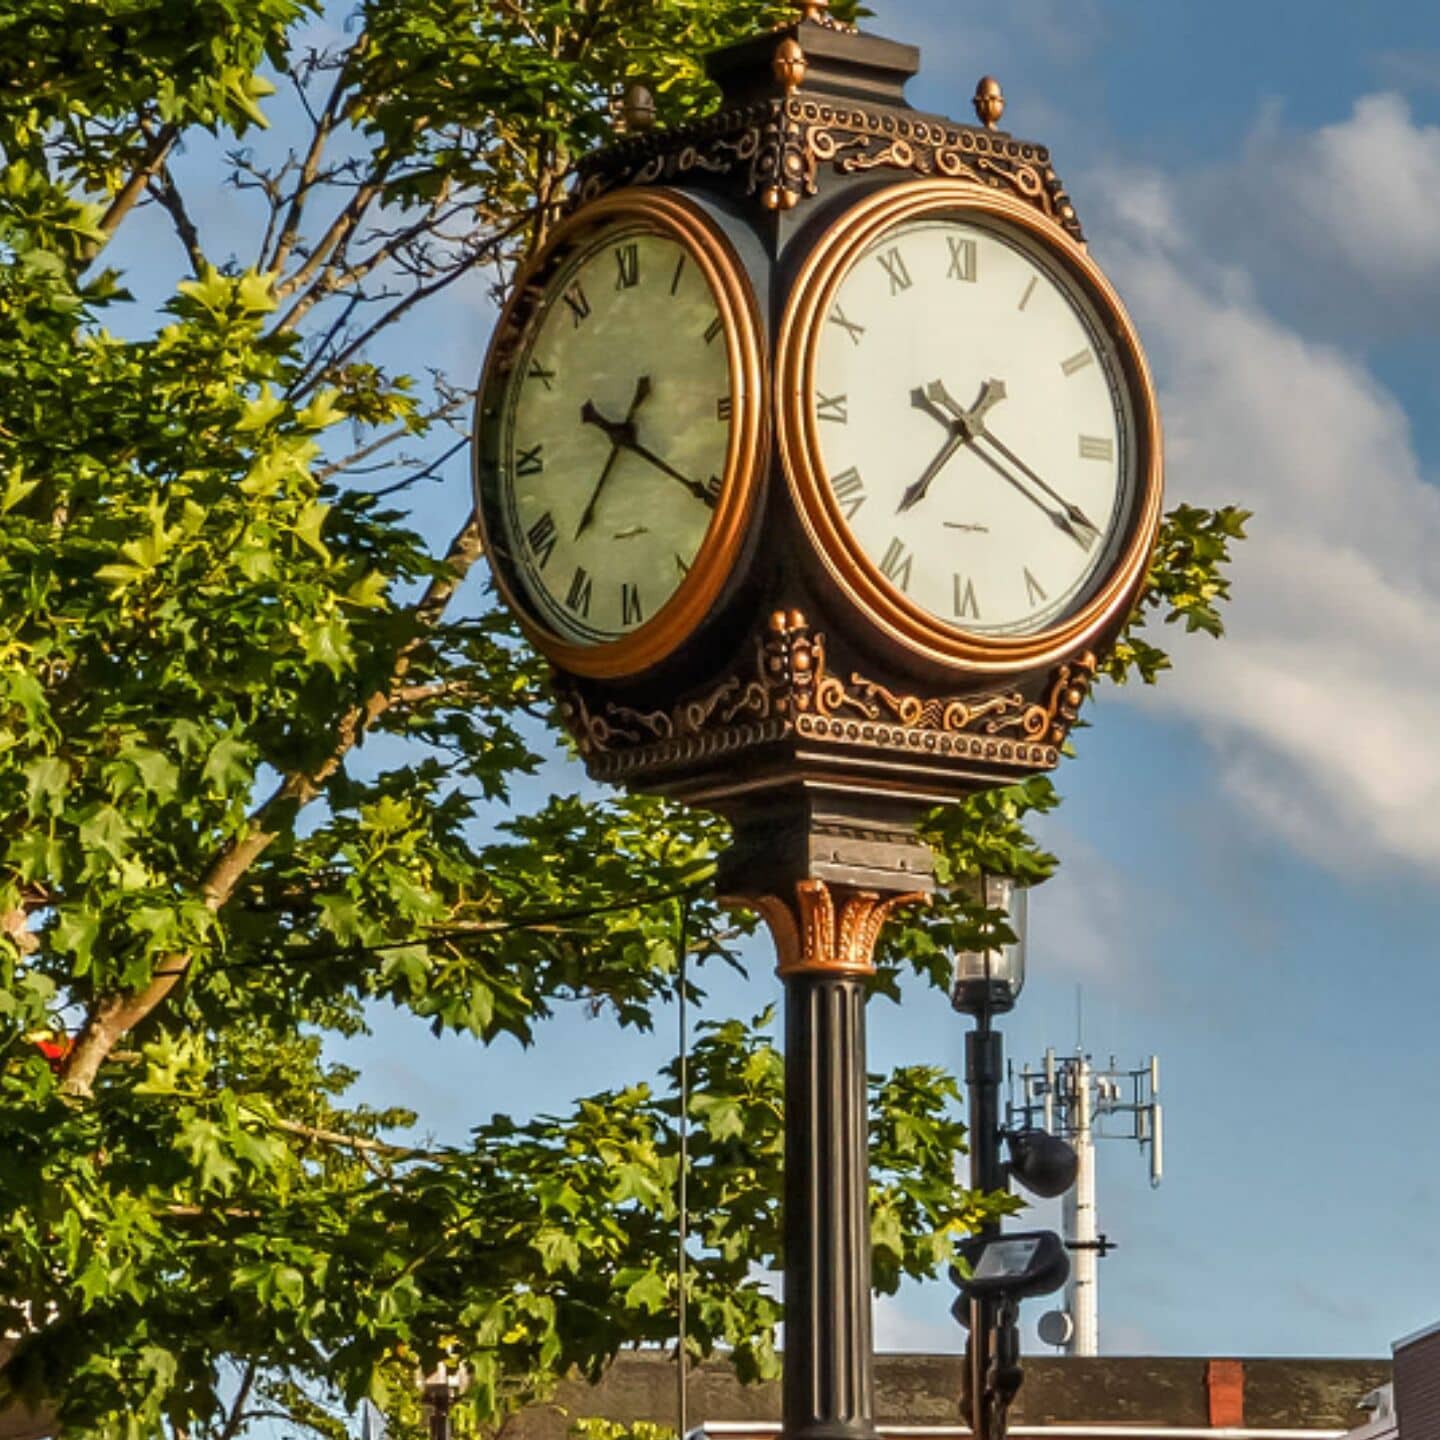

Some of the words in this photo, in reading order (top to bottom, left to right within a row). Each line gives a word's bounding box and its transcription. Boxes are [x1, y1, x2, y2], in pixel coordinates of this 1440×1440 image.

[615, 244, 639, 290] XII
[876, 248, 913, 296] XI
[946, 236, 977, 283] XII
[563, 280, 591, 330] XI
[828, 303, 865, 345] X
[528, 359, 555, 391] X
[816, 391, 847, 423] IX
[516, 444, 543, 477] IX
[1078, 434, 1113, 463] III
[830, 465, 867, 520] VIII
[879, 536, 913, 592] VII
[1023, 566, 1048, 607] V
[566, 566, 593, 618] VII
[621, 583, 643, 625] VI
[953, 573, 980, 619] VI
